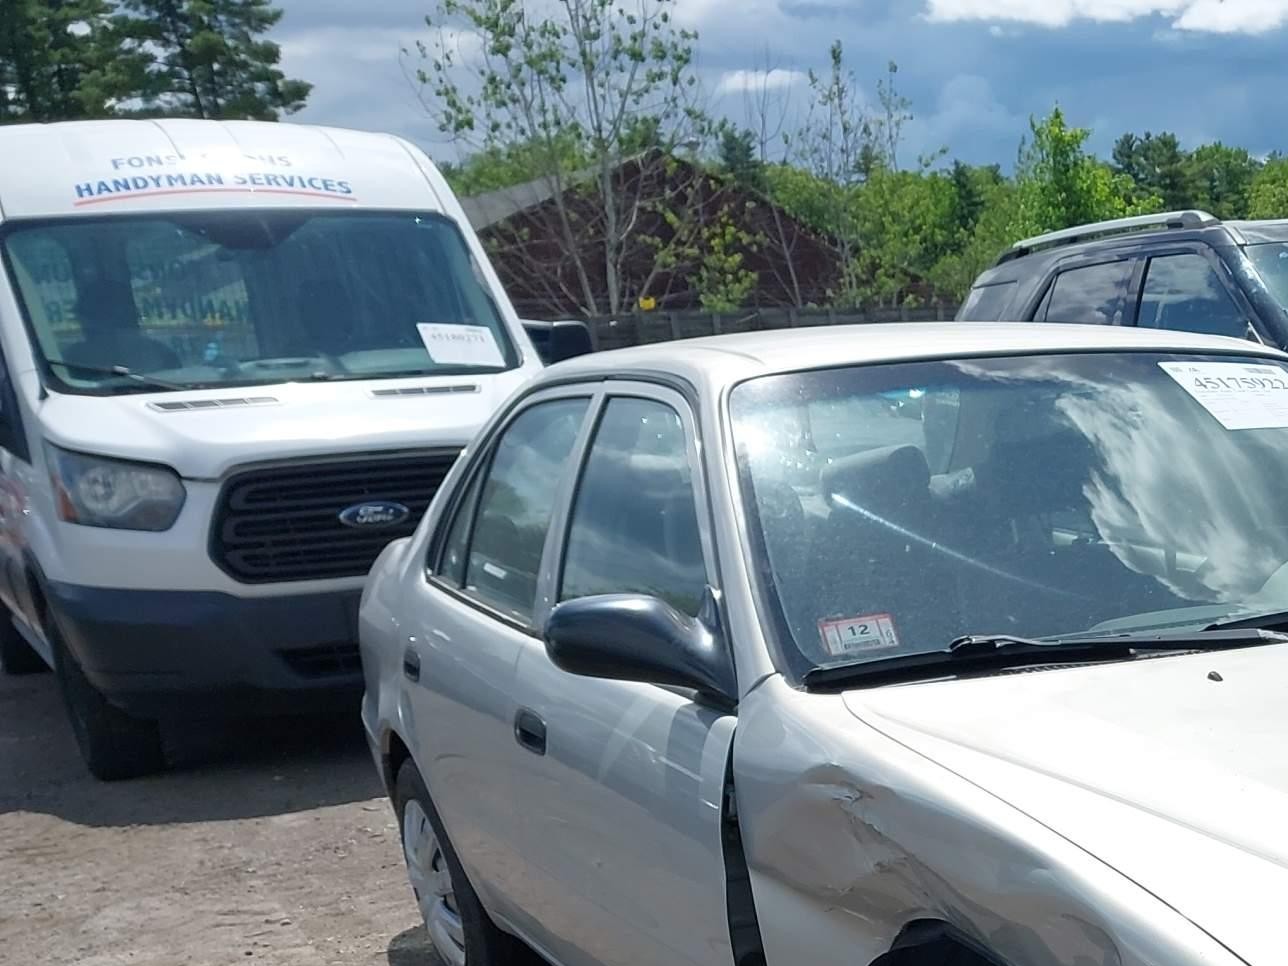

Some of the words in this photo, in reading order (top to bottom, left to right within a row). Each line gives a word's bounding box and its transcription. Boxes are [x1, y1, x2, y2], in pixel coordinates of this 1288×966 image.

[74, 172, 224, 198] HANDYMAN
[233, 172, 353, 194] SERVICES
[848, 624, 871, 637] 12
